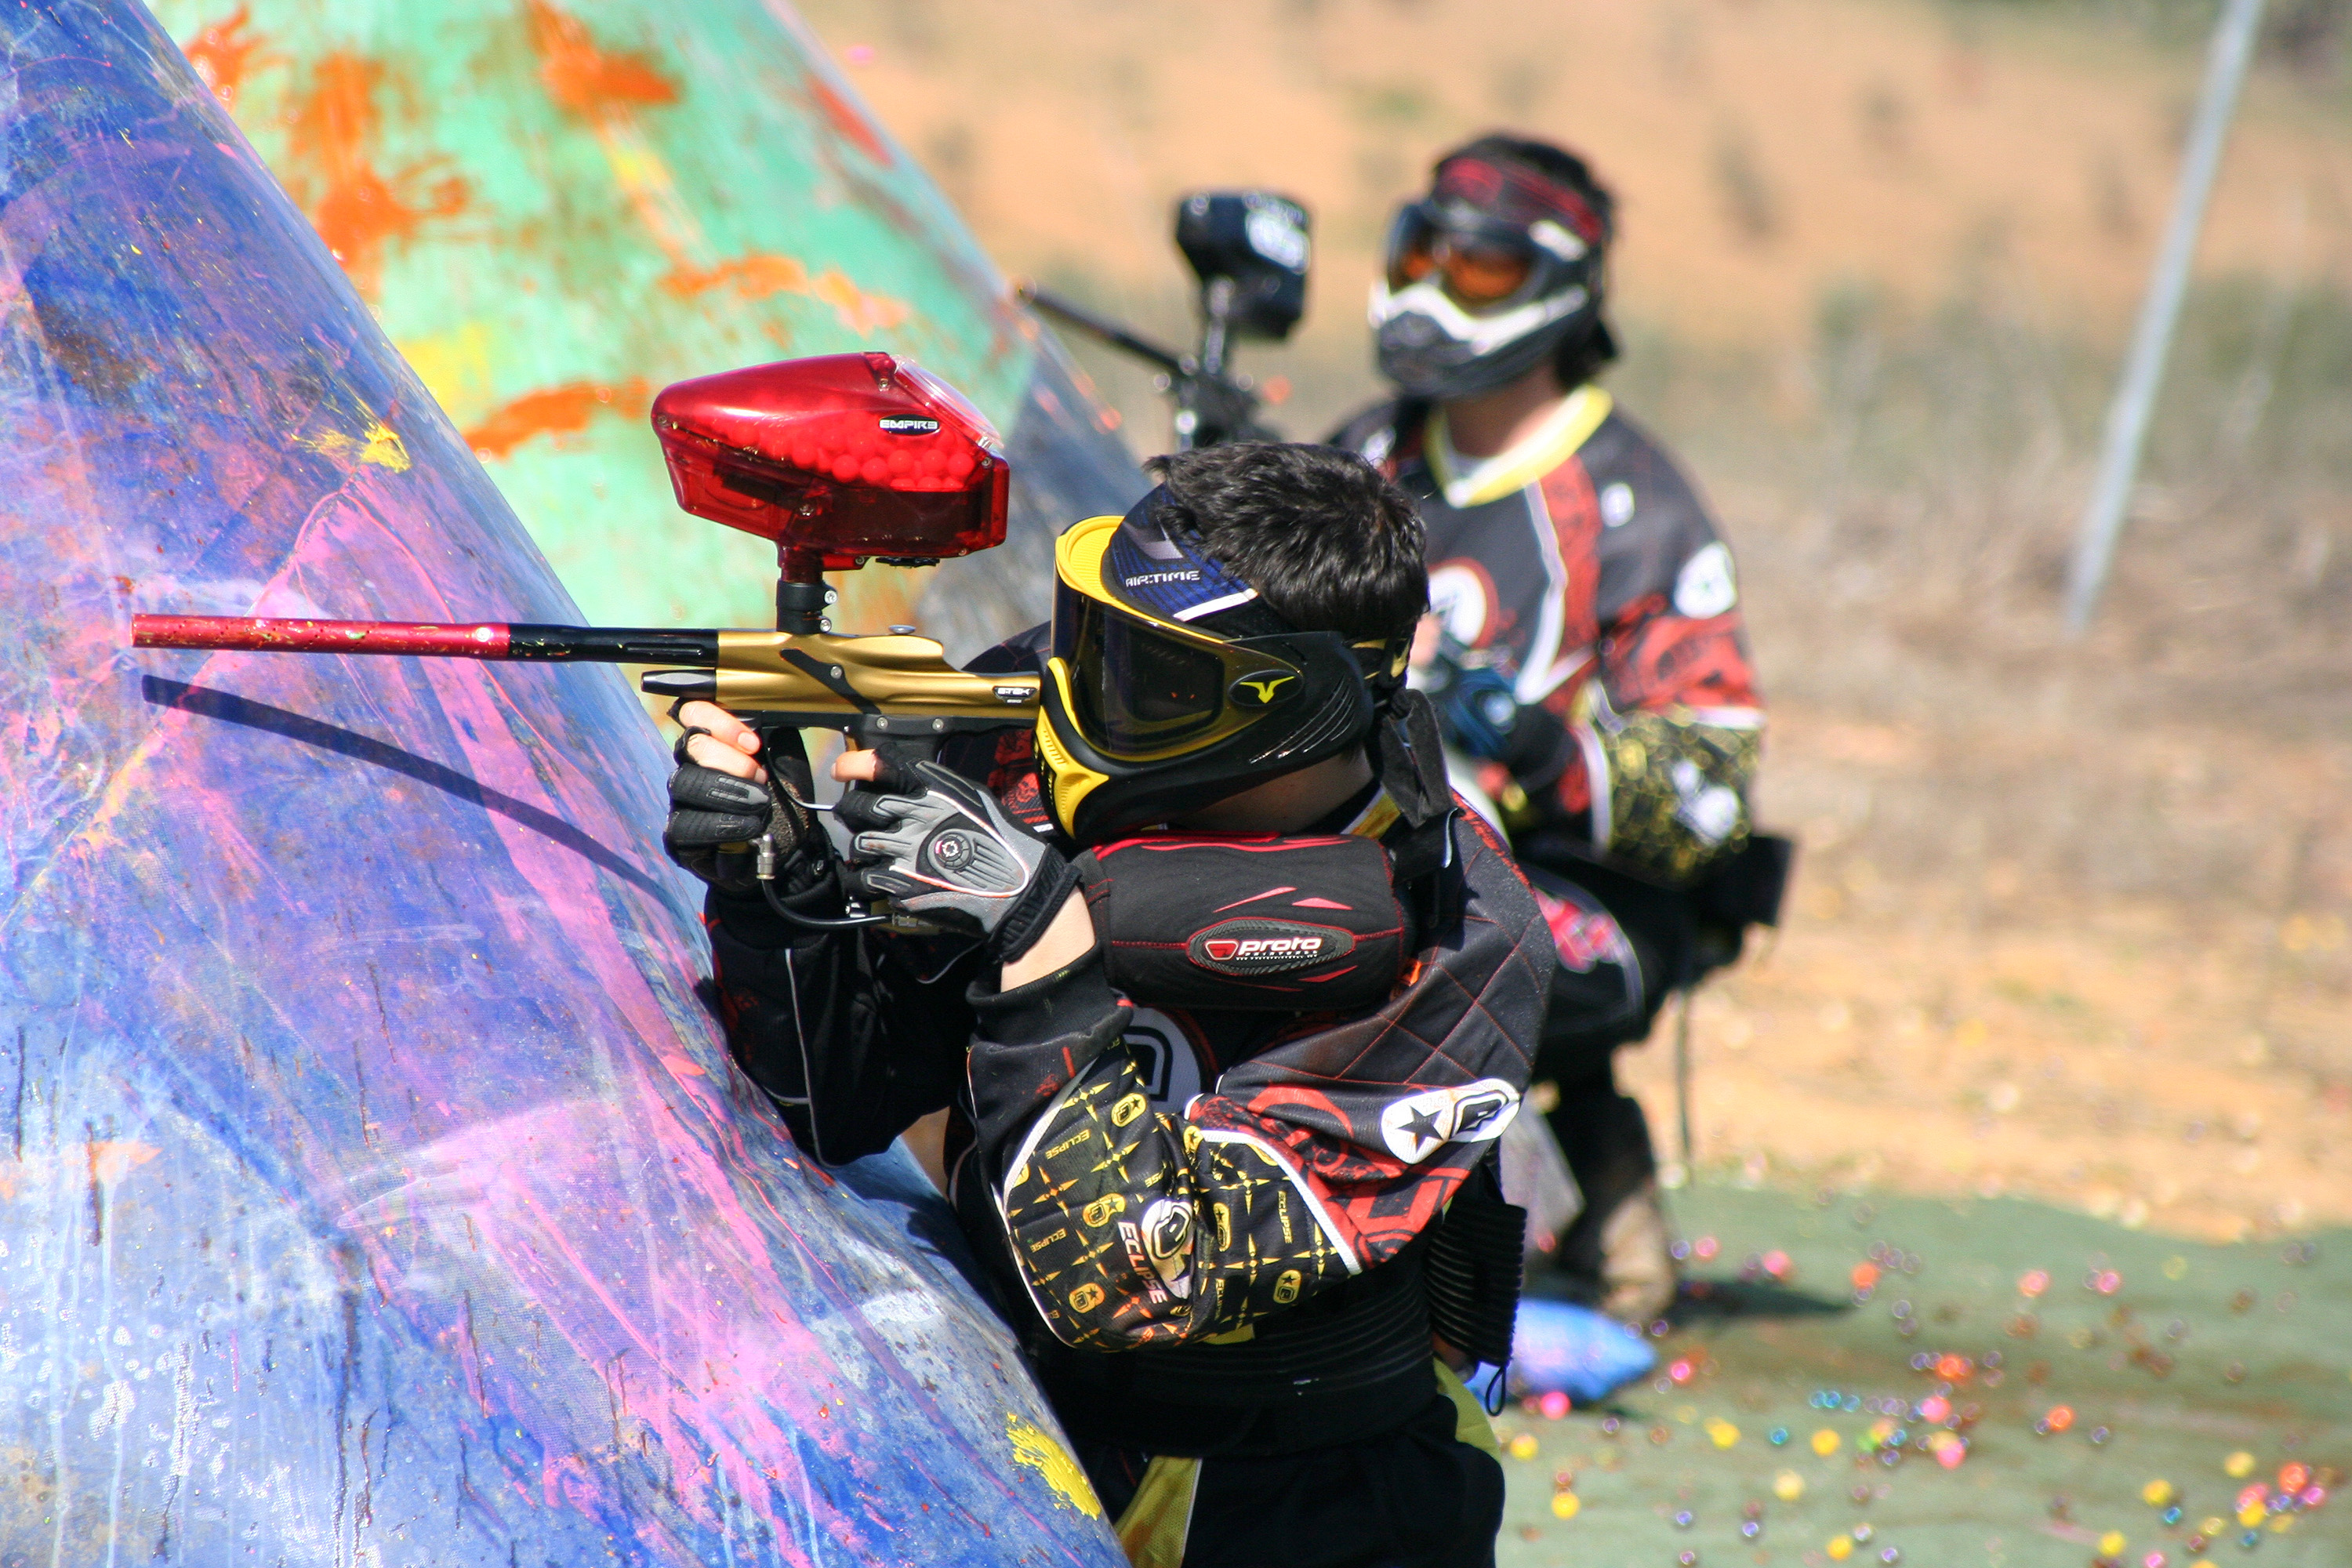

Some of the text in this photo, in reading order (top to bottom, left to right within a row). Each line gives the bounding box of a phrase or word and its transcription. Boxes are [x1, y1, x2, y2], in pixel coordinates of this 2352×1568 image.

[1237, 937, 1322, 956] proto
[1045, 1129, 1091, 1160] ECLIPSE
[1278, 1190, 1293, 1244] ECLIPSE
[1029, 1227, 1067, 1253] ECLIPSE
[1117, 1221, 1169, 1304] ECLIPSE
